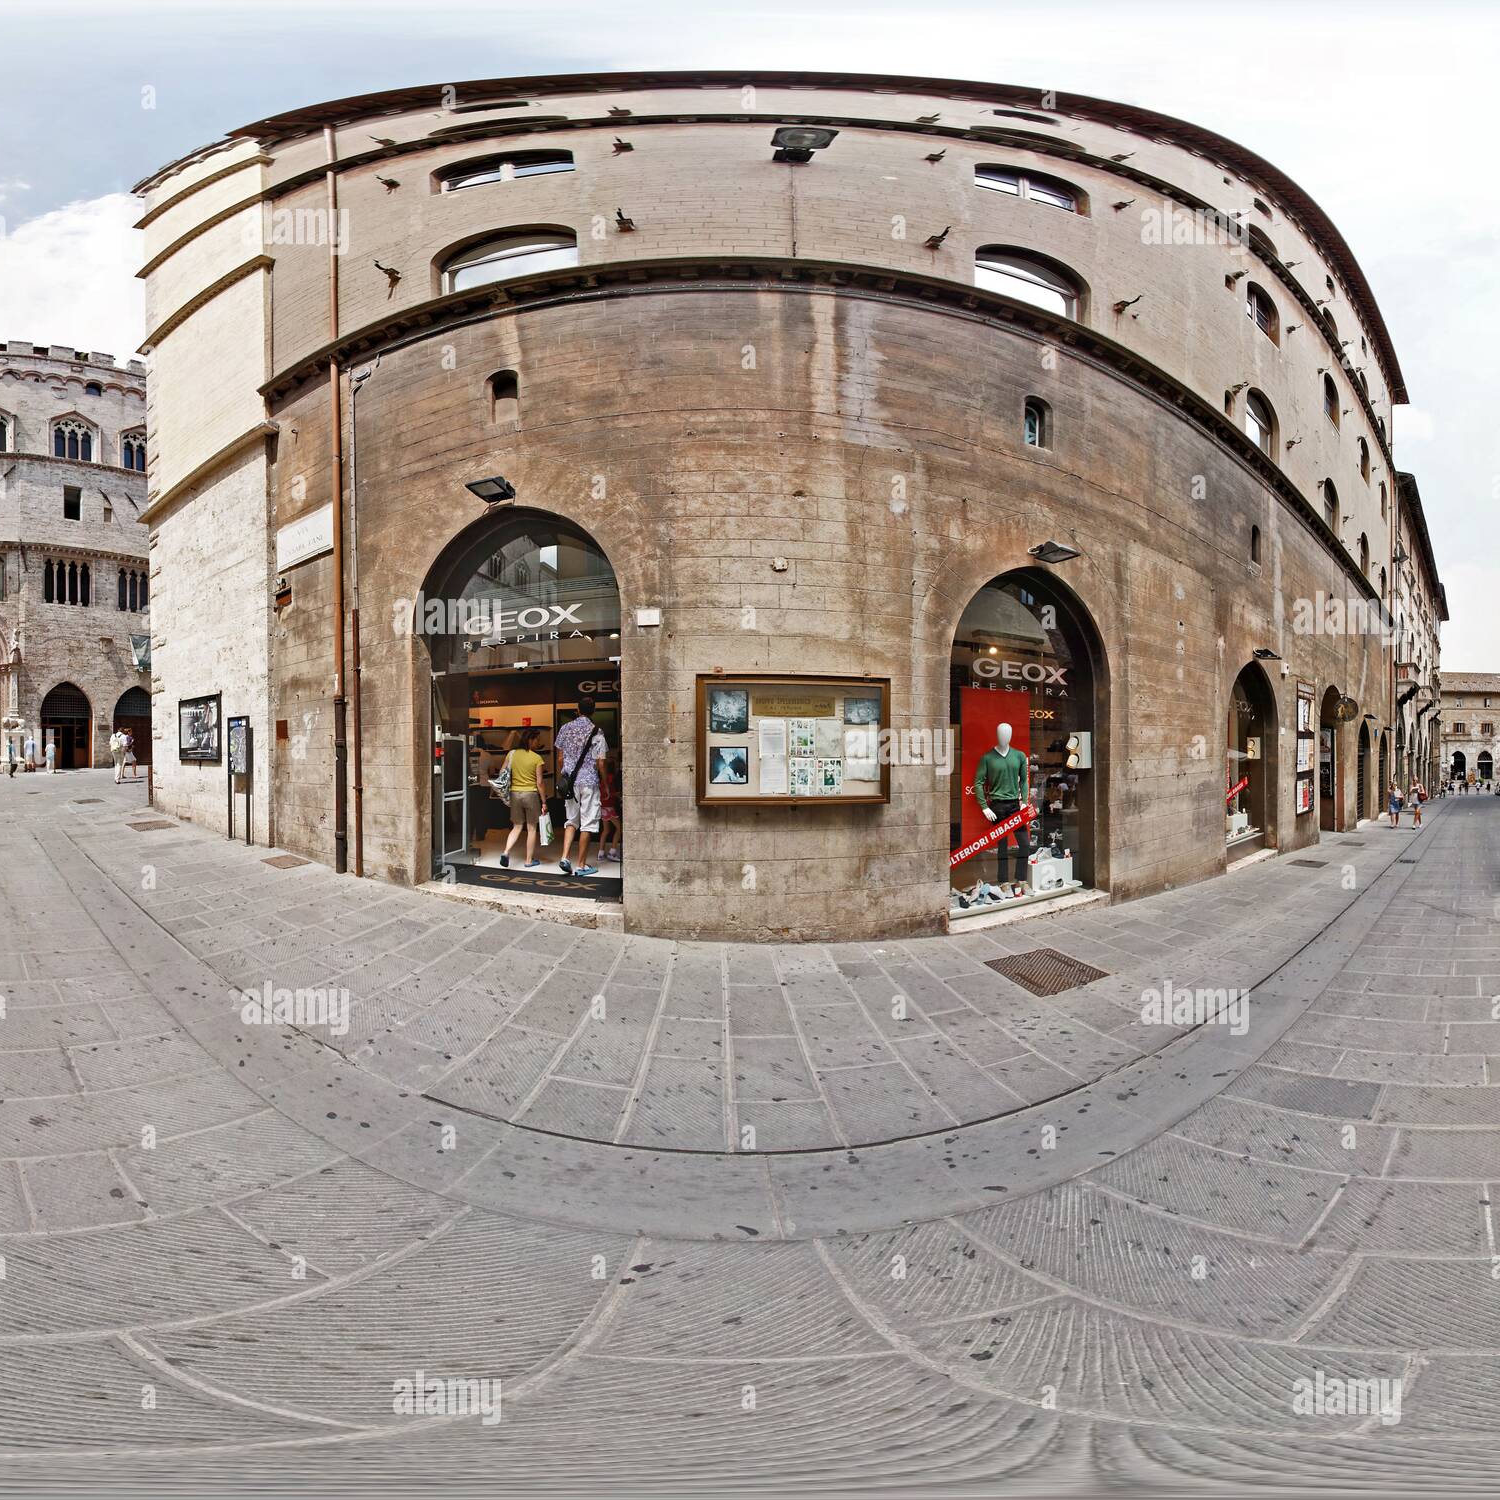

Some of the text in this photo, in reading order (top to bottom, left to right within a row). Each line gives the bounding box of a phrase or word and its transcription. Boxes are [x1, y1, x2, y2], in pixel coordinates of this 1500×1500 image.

[463, 603, 584, 635] GEOX
[463, 629, 584, 650] RESPIRA
[972, 657, 1068, 686] GEOX
[972, 681, 1068, 697] RESPIRA
[1030, 709, 1055, 720] EOX
[989, 815, 1022, 841] RIBASSI
[480, 874, 600, 891] GEOX
